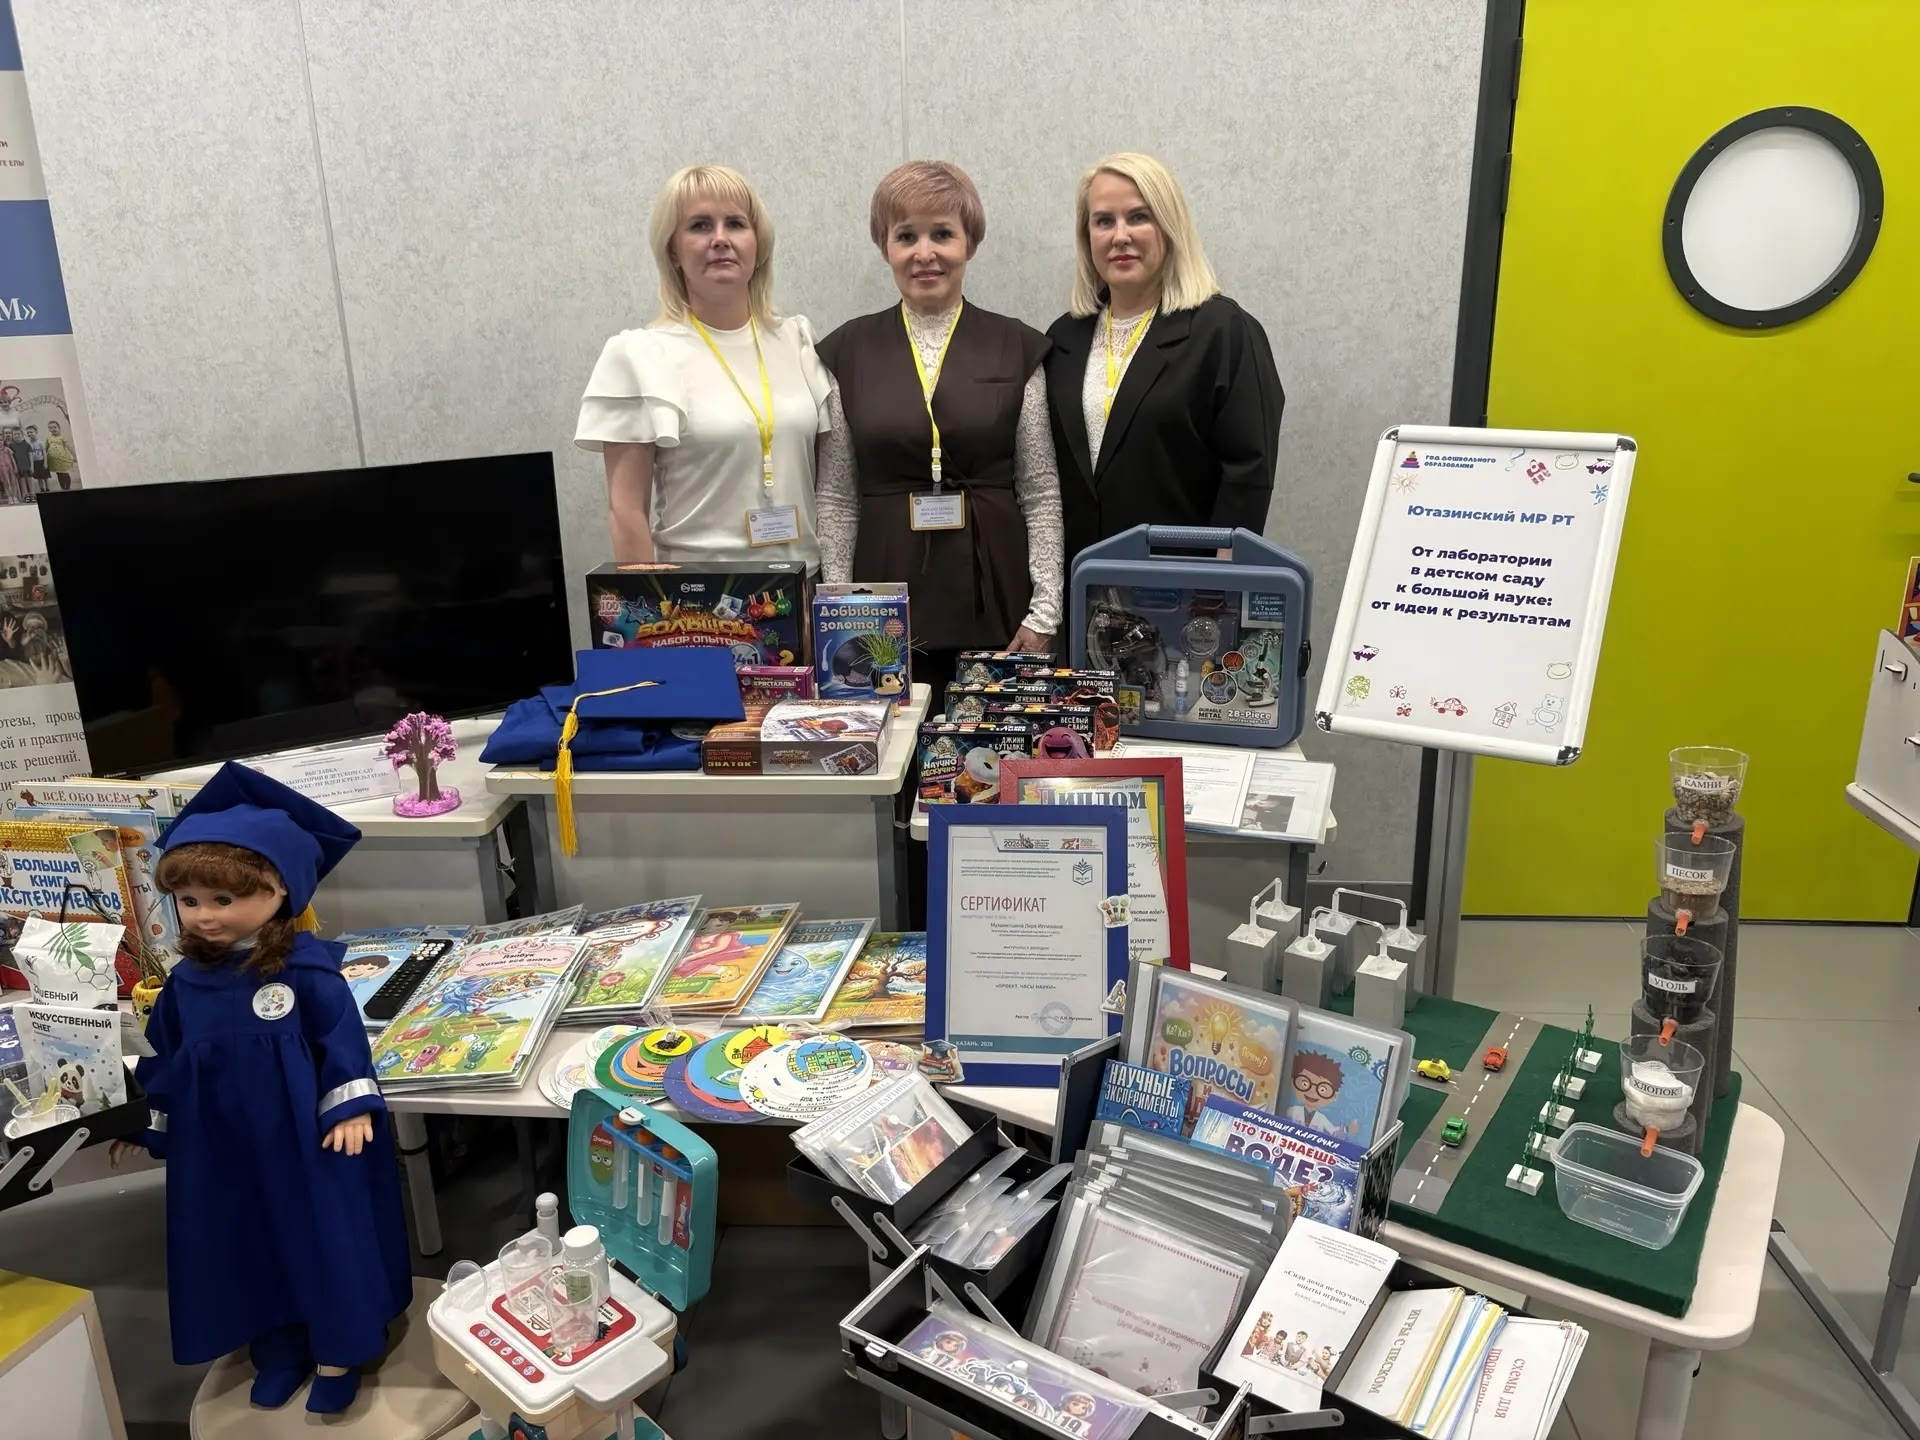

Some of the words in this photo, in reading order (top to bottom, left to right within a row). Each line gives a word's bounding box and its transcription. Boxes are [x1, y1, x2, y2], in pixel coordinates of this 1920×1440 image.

[1407, 505, 1516, 523] Ютазинский
[1519, 512, 1548, 525] МР
[1551, 514, 1575, 526] РТ
[1411, 546, 1434, 558] От
[1437, 549, 1552, 567] лаборатории
[1411, 566, 1421, 575] в
[1424, 567, 1498, 583] детском
[1502, 573, 1545, 588] саду
[1396, 583, 1407, 593] к
[1411, 583, 1490, 601] большой
[1494, 589, 1553, 607] науке:
[601, 601, 619, 610] 100
[820, 606, 898, 617] Добываем
[1371, 600, 1391, 610] от
[1394, 603, 1438, 617] идеи
[1442, 607, 1453, 617] к
[1457, 608, 1571, 628] результатам
[637, 617, 757, 637] БОЛЬШОЙ
[820, 619, 880, 632] золото!
[652, 636, 690, 648] НАБОР
[1060, 716, 1089, 724] ВЕСЁЛЫЙ
[1228, 710, 1271, 719] 28-Piece
[19, 738, 27, 747] и
[1002, 736, 1025, 744] ДЖИНН
[24, 751, 81, 770] решений.
[924, 759, 957, 769] НАУЧНО
[921, 766, 957, 777] НЕСКУЧНО
[1684, 779, 1722, 788] КАМНИ
[42, 790, 65, 802] ВСЁ
[69, 792, 93, 802] ОБО
[99, 791, 131, 804] ВСЁМ
[13, 858, 81, 874] БОЛЬШАЯ
[1672, 868, 1707, 880] ПЕСОК
[30, 874, 71, 889] КНИГА
[0, 886, 122, 911] КСПЕРИМЕНТОВ
[961, 896, 1047, 912] СЕРТИФИКАТ
[1653, 977, 1688, 991] УГОЛЬ
[29, 1010, 112, 1029] ИСКУССТВЕННЫЙ
[32, 1021, 51, 1032] СНЕГ
[1109, 1065, 1176, 1099] НАУЧНЫЕ
[1169, 1048, 1255, 1102] ВОПРОСЫ
[1633, 1080, 1679, 1096] ХЛОПОК
[1104, 1088, 1180, 1118] ЭКСПЕРИМЕНТЫ
[1242, 1110, 1296, 1136] ОБУЧАЮЩИЕ
[1296, 1127, 1341, 1149] КАРТОЧКИ
[1232, 1120, 1256, 1136] ЧТО
[1259, 1130, 1276, 1144] ТЫ
[1279, 1136, 1337, 1166] ЗНАЕШЬ
[1401, 1308, 1422, 1341] ИГРЫ
[1368, 1347, 1401, 1394] ПЕСКОМ
[1505, 1358, 1526, 1394] схемы
[1494, 1397, 1512, 1419] для
[1060, 1415, 1082, 1433] 19
